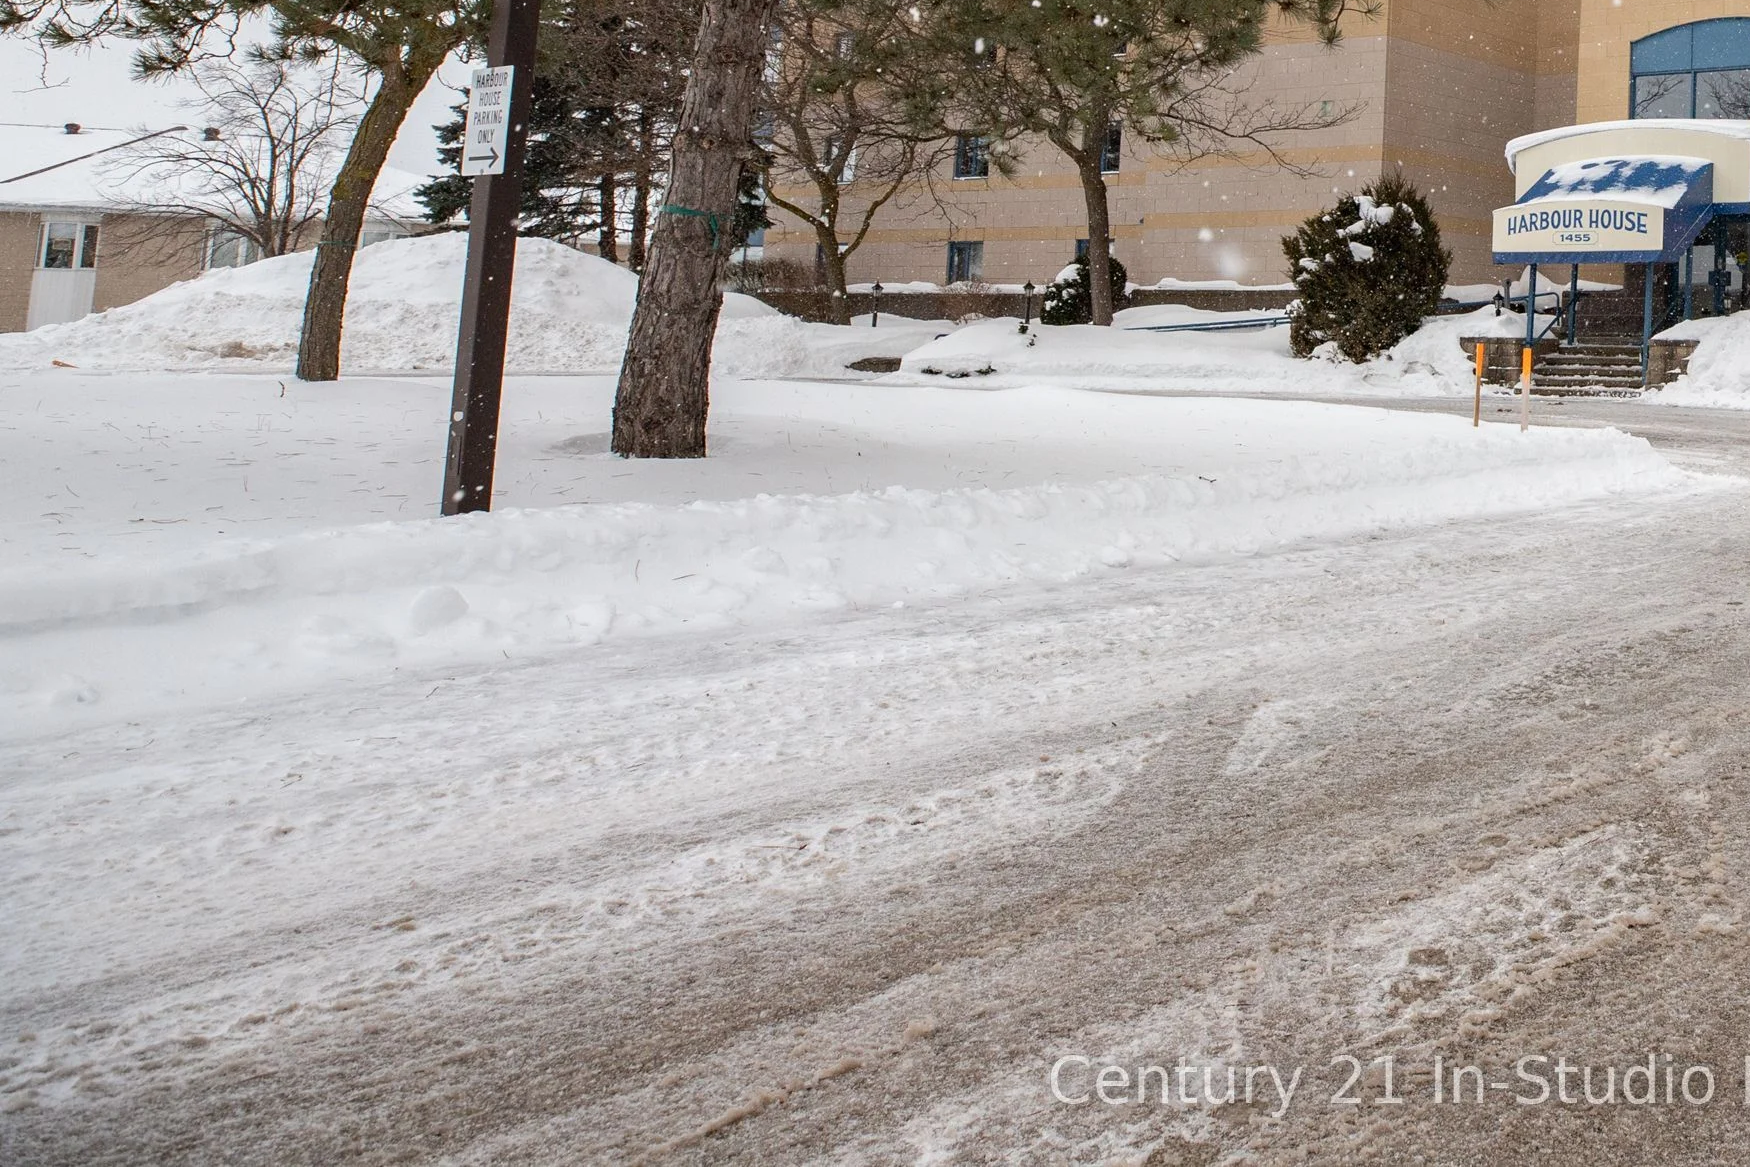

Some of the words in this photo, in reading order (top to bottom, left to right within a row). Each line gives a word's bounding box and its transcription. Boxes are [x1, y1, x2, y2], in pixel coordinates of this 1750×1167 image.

[476, 72, 508, 89] HARBOUR
[479, 91, 502, 107] HOUSE
[473, 110, 503, 126] PARKING
[477, 129, 495, 144] ONLY
[1508, 209, 1583, 235] HARBOUR
[1589, 208, 1648, 234] HOUSE
[1559, 233, 1591, 242] 1455
